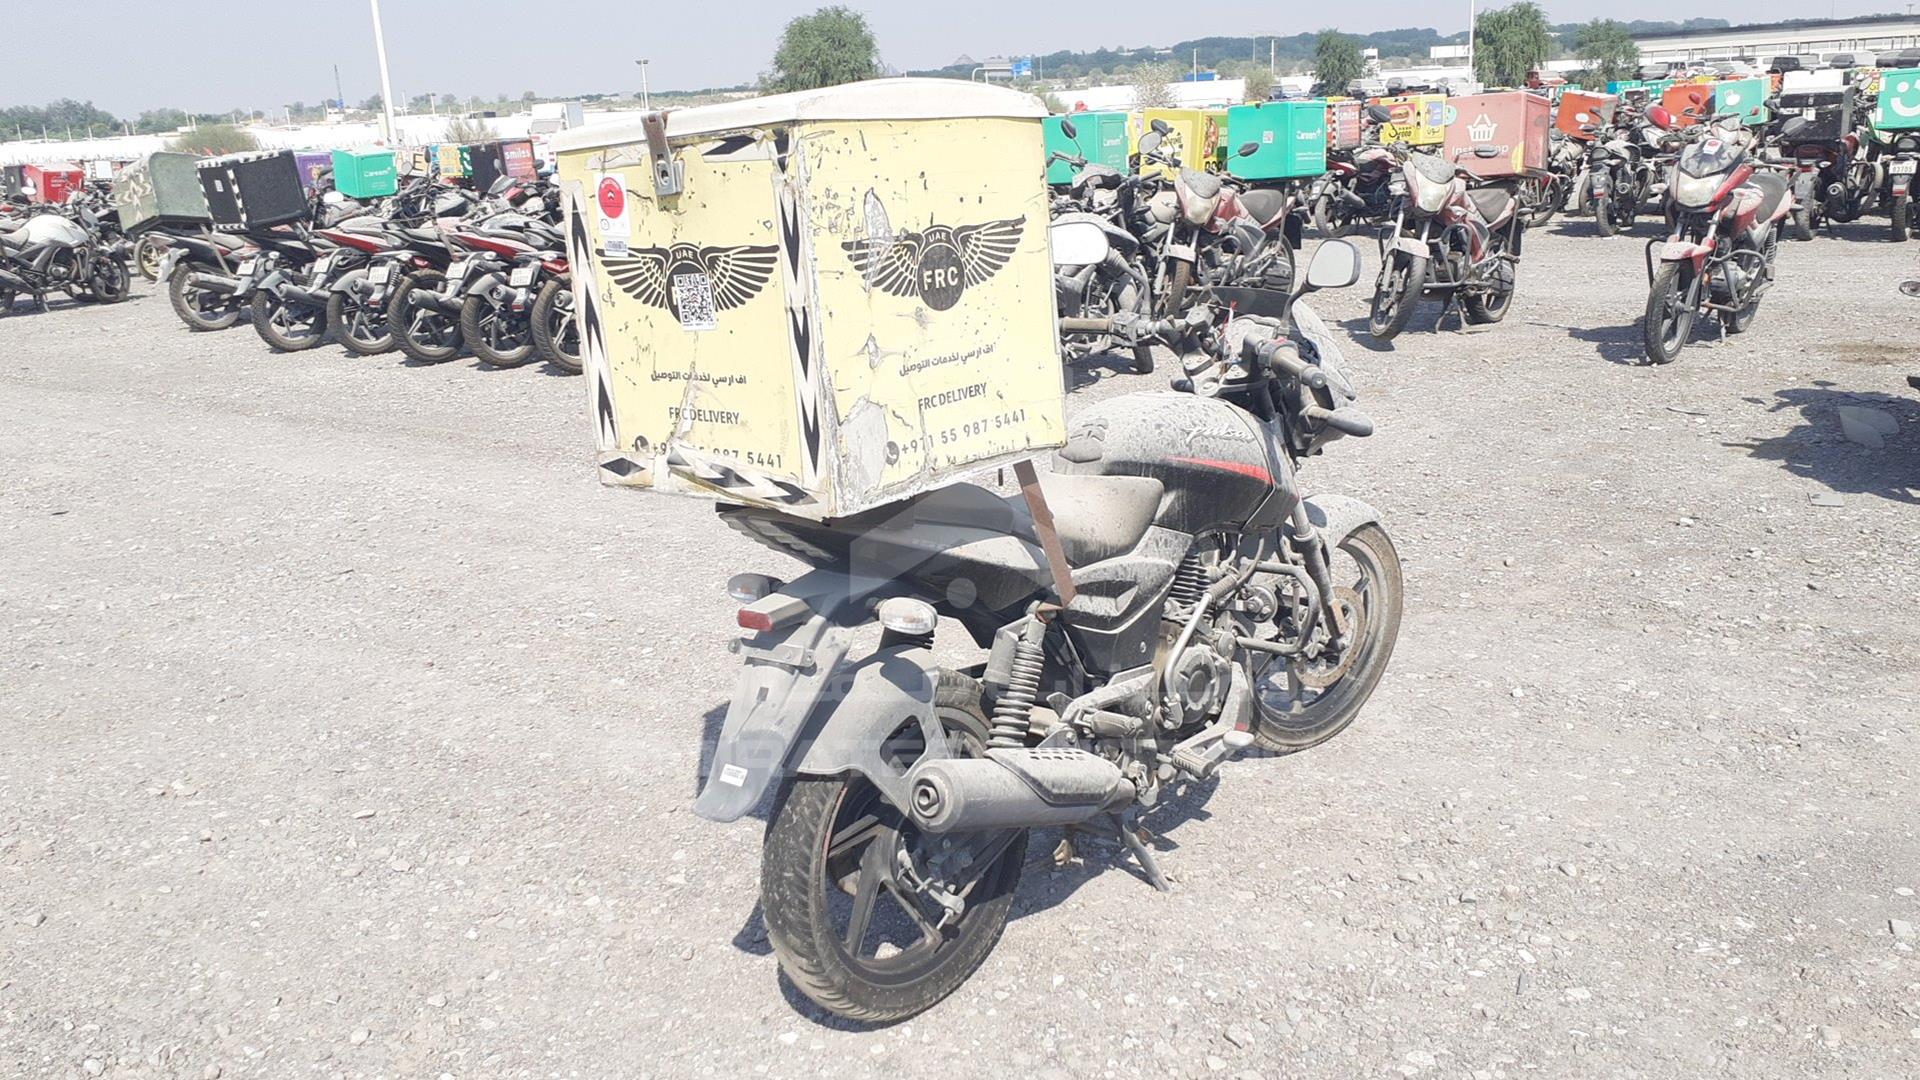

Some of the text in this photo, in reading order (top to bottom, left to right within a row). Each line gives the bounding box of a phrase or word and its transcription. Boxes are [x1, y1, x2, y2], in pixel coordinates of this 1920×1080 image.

[927, 231, 946, 242] UAE
[674, 248, 695, 260] UAE
[922, 266, 959, 292] FRC
[918, 382, 988, 412] FRC DELIVERY
[690, 409, 740, 425] DELIVERY
[901, 408, 1026, 454] +971 55 987 5441
[746, 452, 782, 468] 5441
